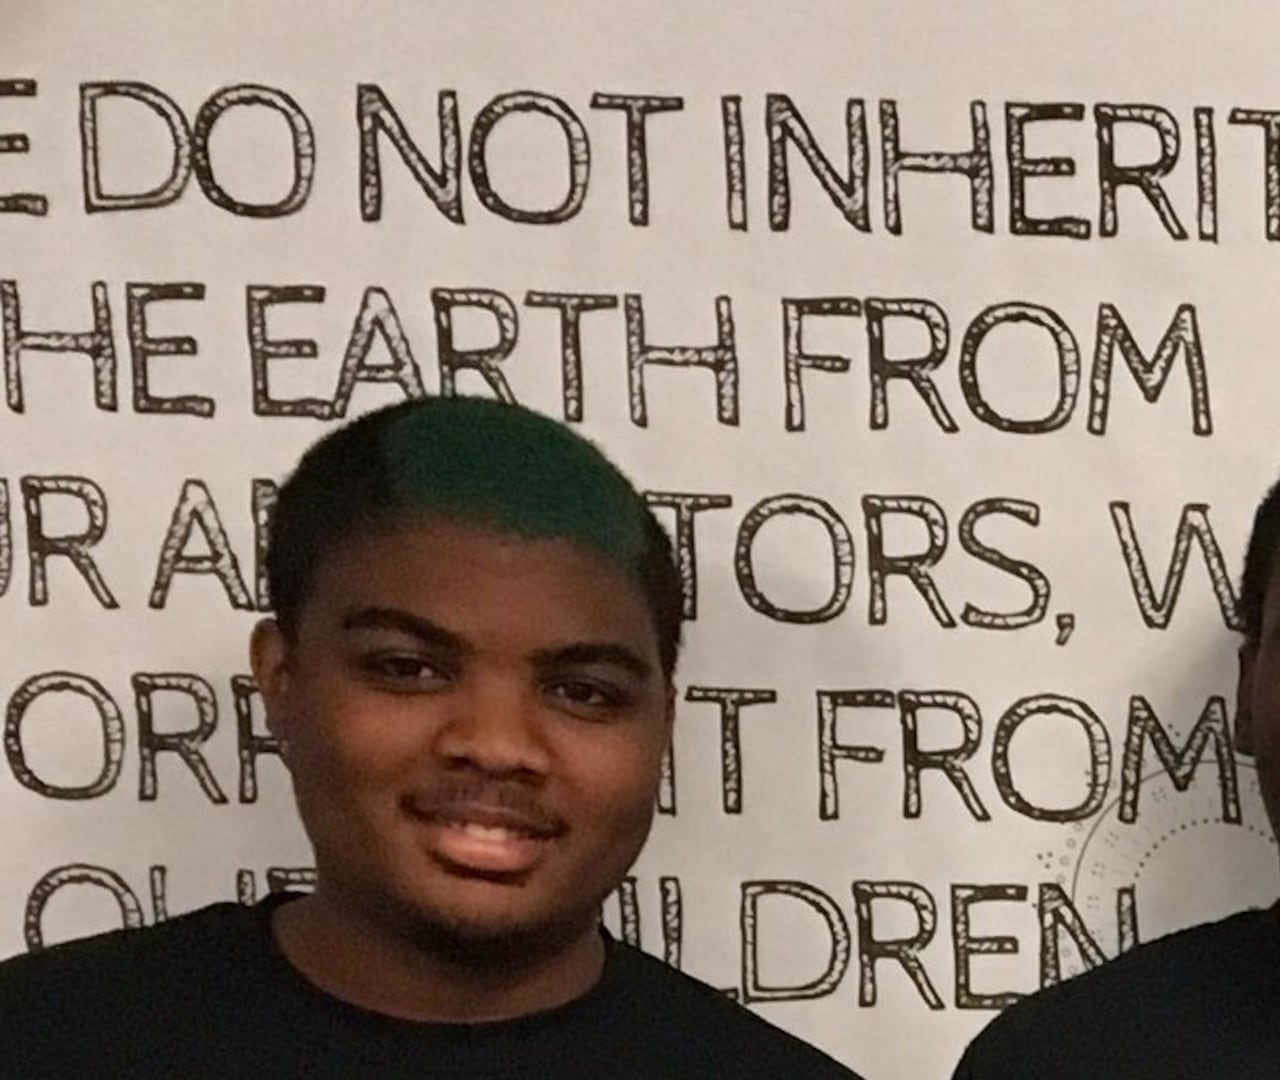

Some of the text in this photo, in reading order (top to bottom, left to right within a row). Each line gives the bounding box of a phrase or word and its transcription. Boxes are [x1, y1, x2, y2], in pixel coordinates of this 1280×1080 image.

[80, 81, 314, 218] DO
[357, 83, 683, 225] NOT
[245, 285, 740, 428] EARTH
[782, 297, 1213, 436] FROM
[816, 690, 1242, 824] FROM
